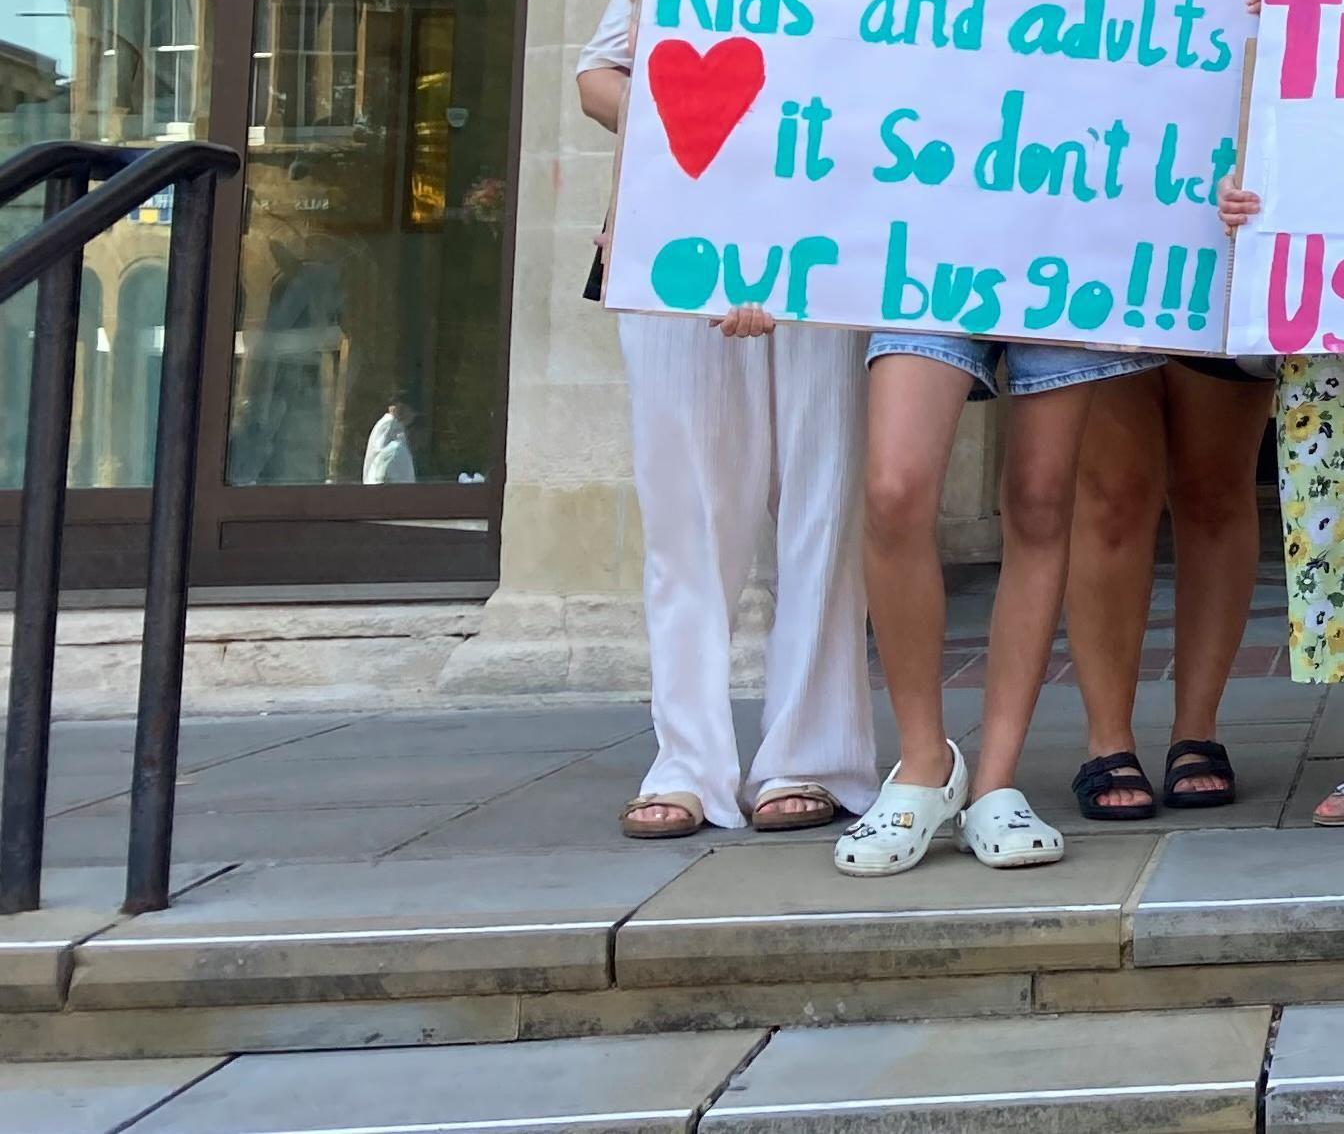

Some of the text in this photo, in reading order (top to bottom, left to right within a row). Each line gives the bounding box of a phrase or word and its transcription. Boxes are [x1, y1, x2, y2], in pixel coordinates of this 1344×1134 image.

[774, 96, 835, 182] it
[973, 89, 1130, 203] don't
[1155, 122, 1237, 206] let
[650, 220, 1218, 336] our bus go!!!
